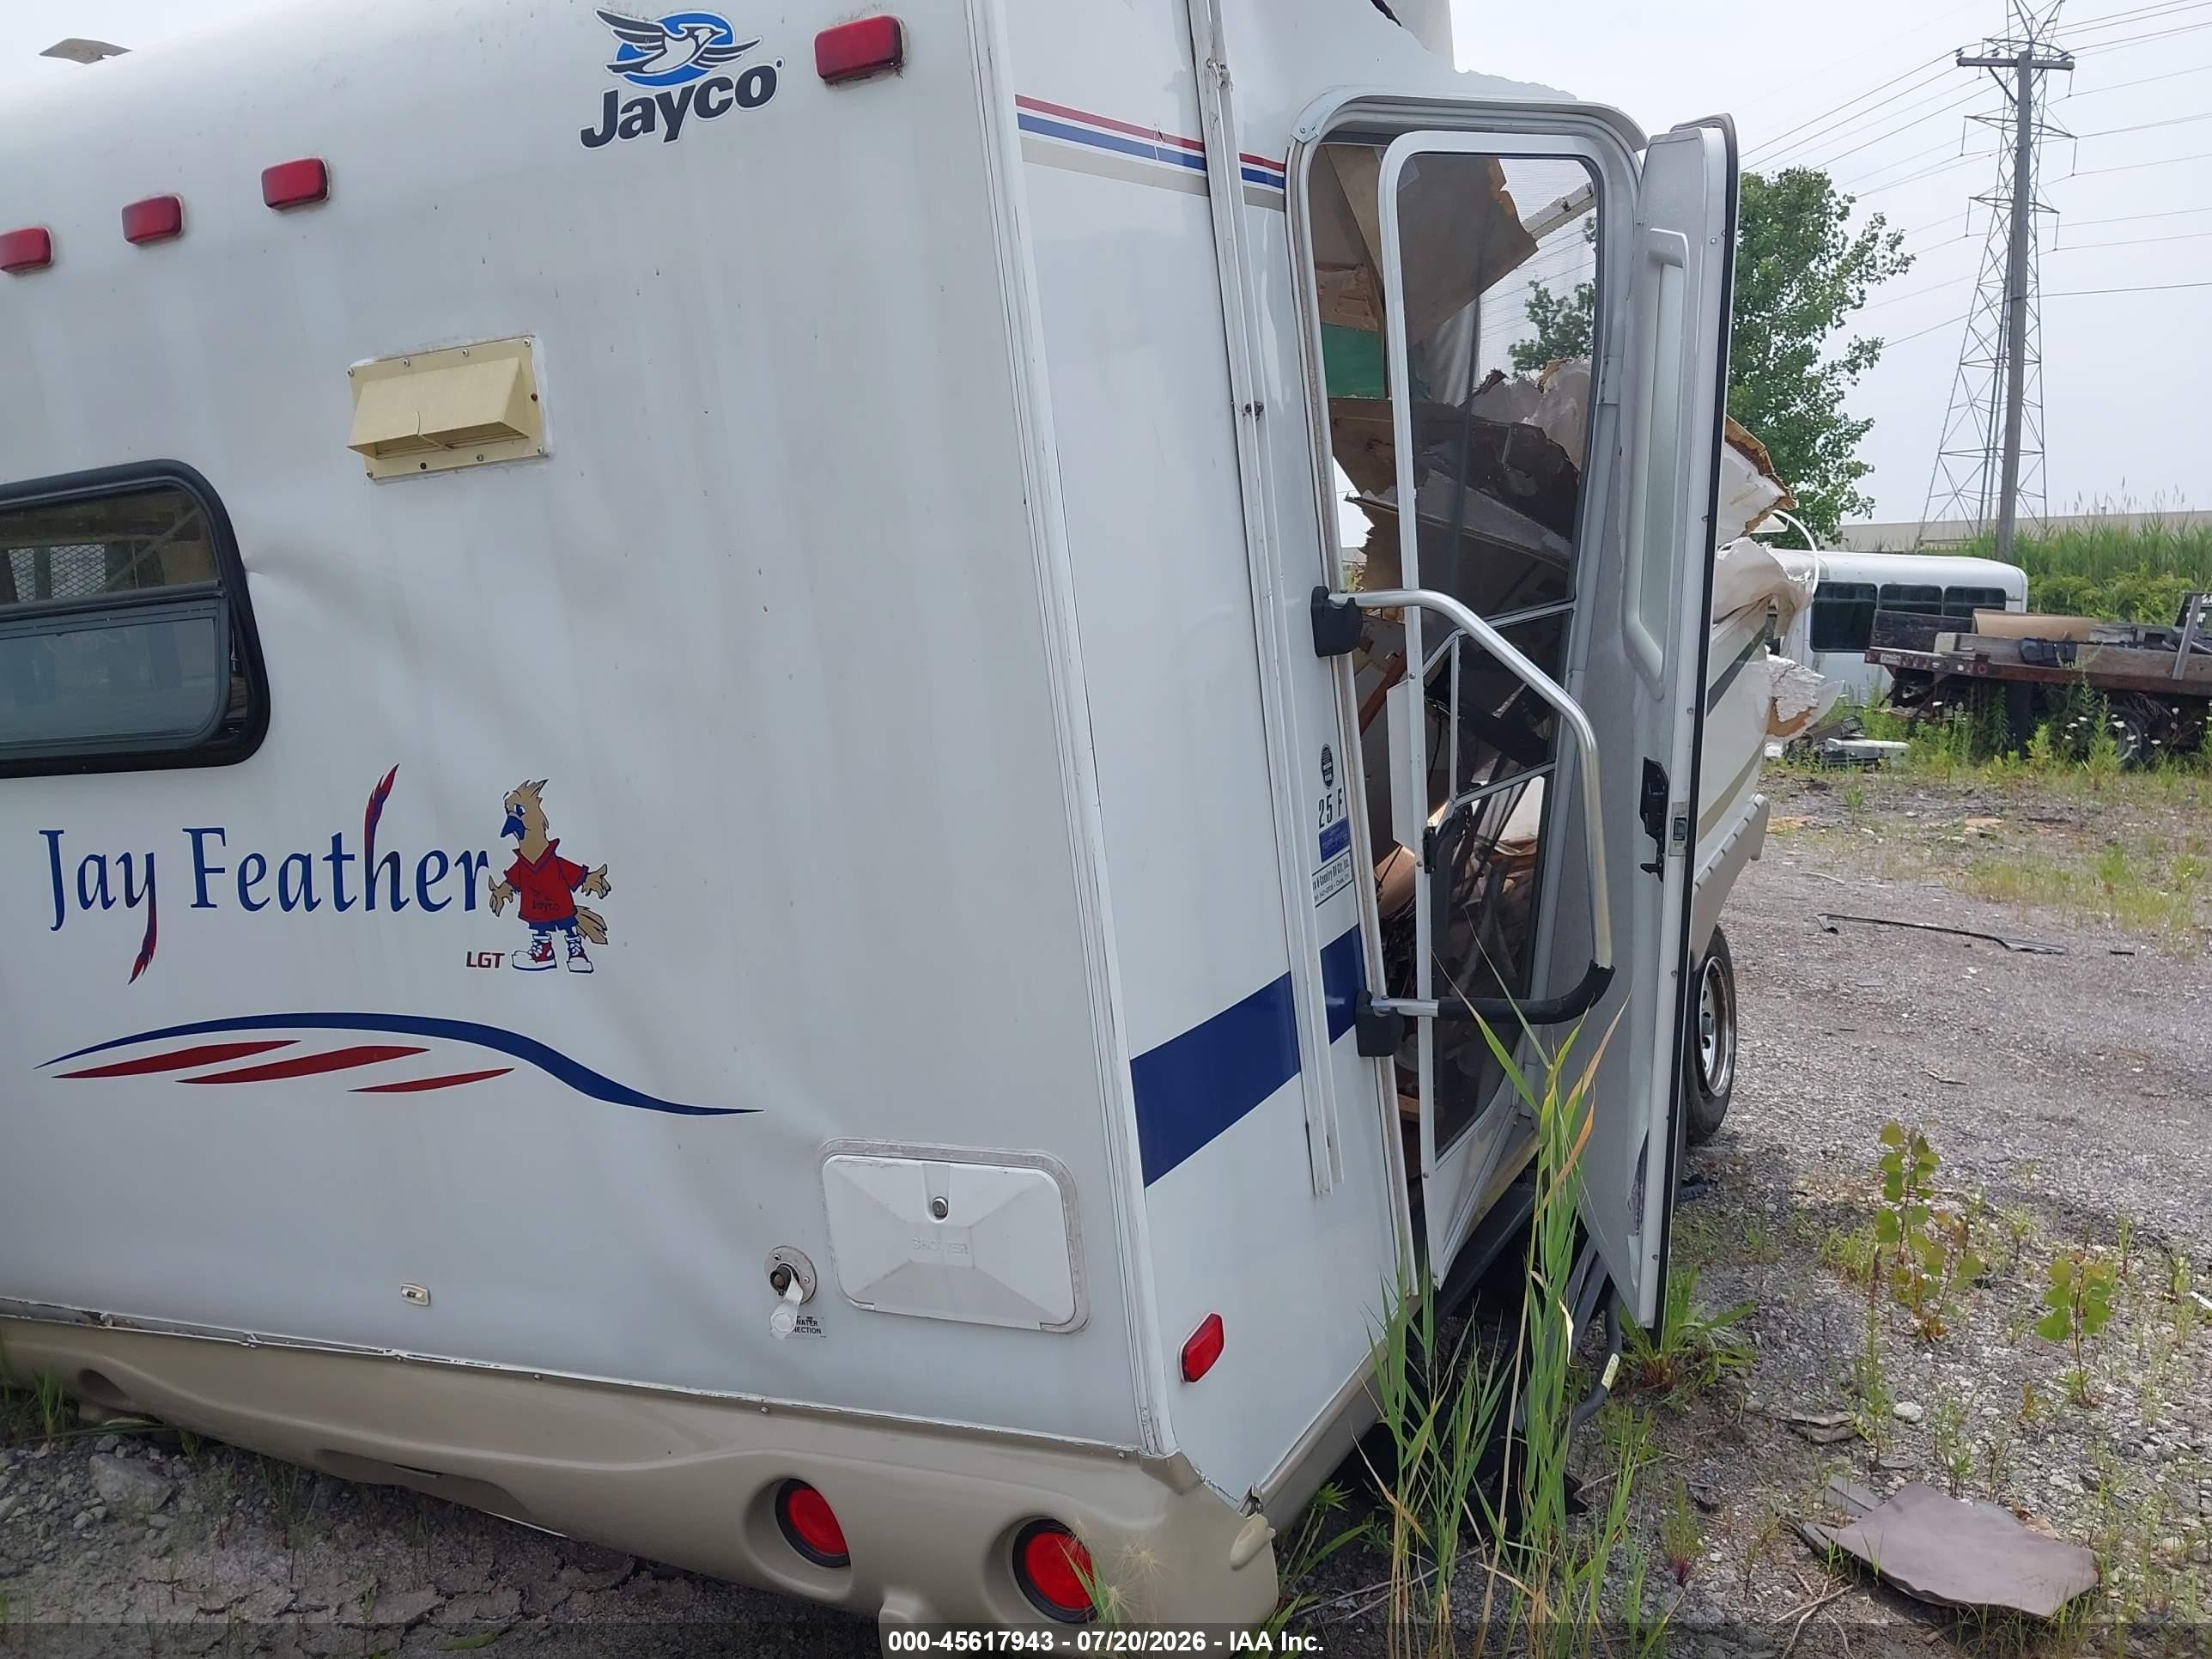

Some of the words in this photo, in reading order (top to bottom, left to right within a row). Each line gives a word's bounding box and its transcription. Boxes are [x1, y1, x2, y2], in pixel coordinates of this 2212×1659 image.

[580, 64, 778, 149] Jayco
[1318, 793, 1334, 830] 25
[1337, 787, 1343, 818] F
[40, 829, 158, 985] Jay
[182, 763, 489, 913] Feather
[465, 951, 506, 969] LGT
